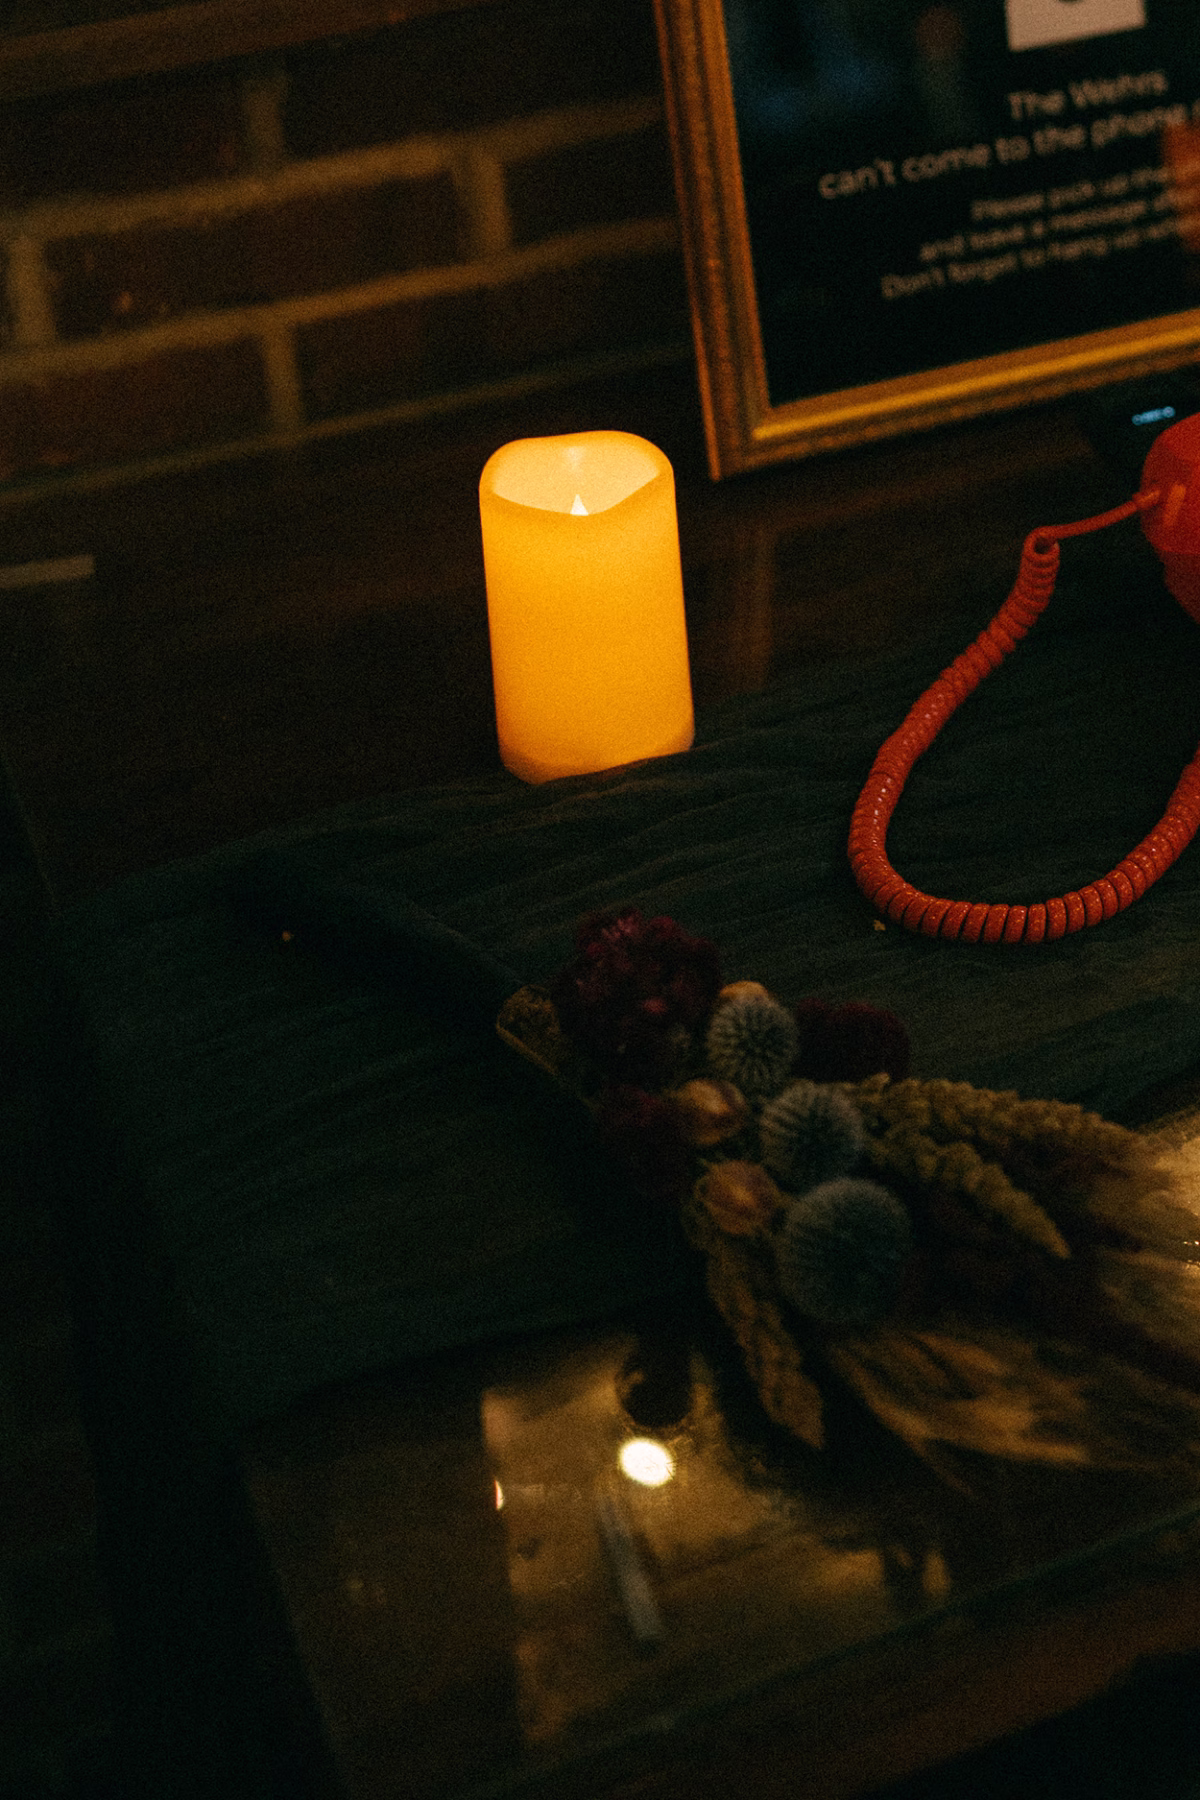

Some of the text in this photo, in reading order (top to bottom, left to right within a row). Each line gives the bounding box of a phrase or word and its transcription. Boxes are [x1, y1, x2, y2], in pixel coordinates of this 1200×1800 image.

[1006, 89, 1065, 121] The
[818, 158, 896, 200] can't
[902, 143, 991, 182] come
[995, 136, 1031, 165] to
[1033, 122, 1087, 156] the
[1091, 104, 1187, 148] phone
